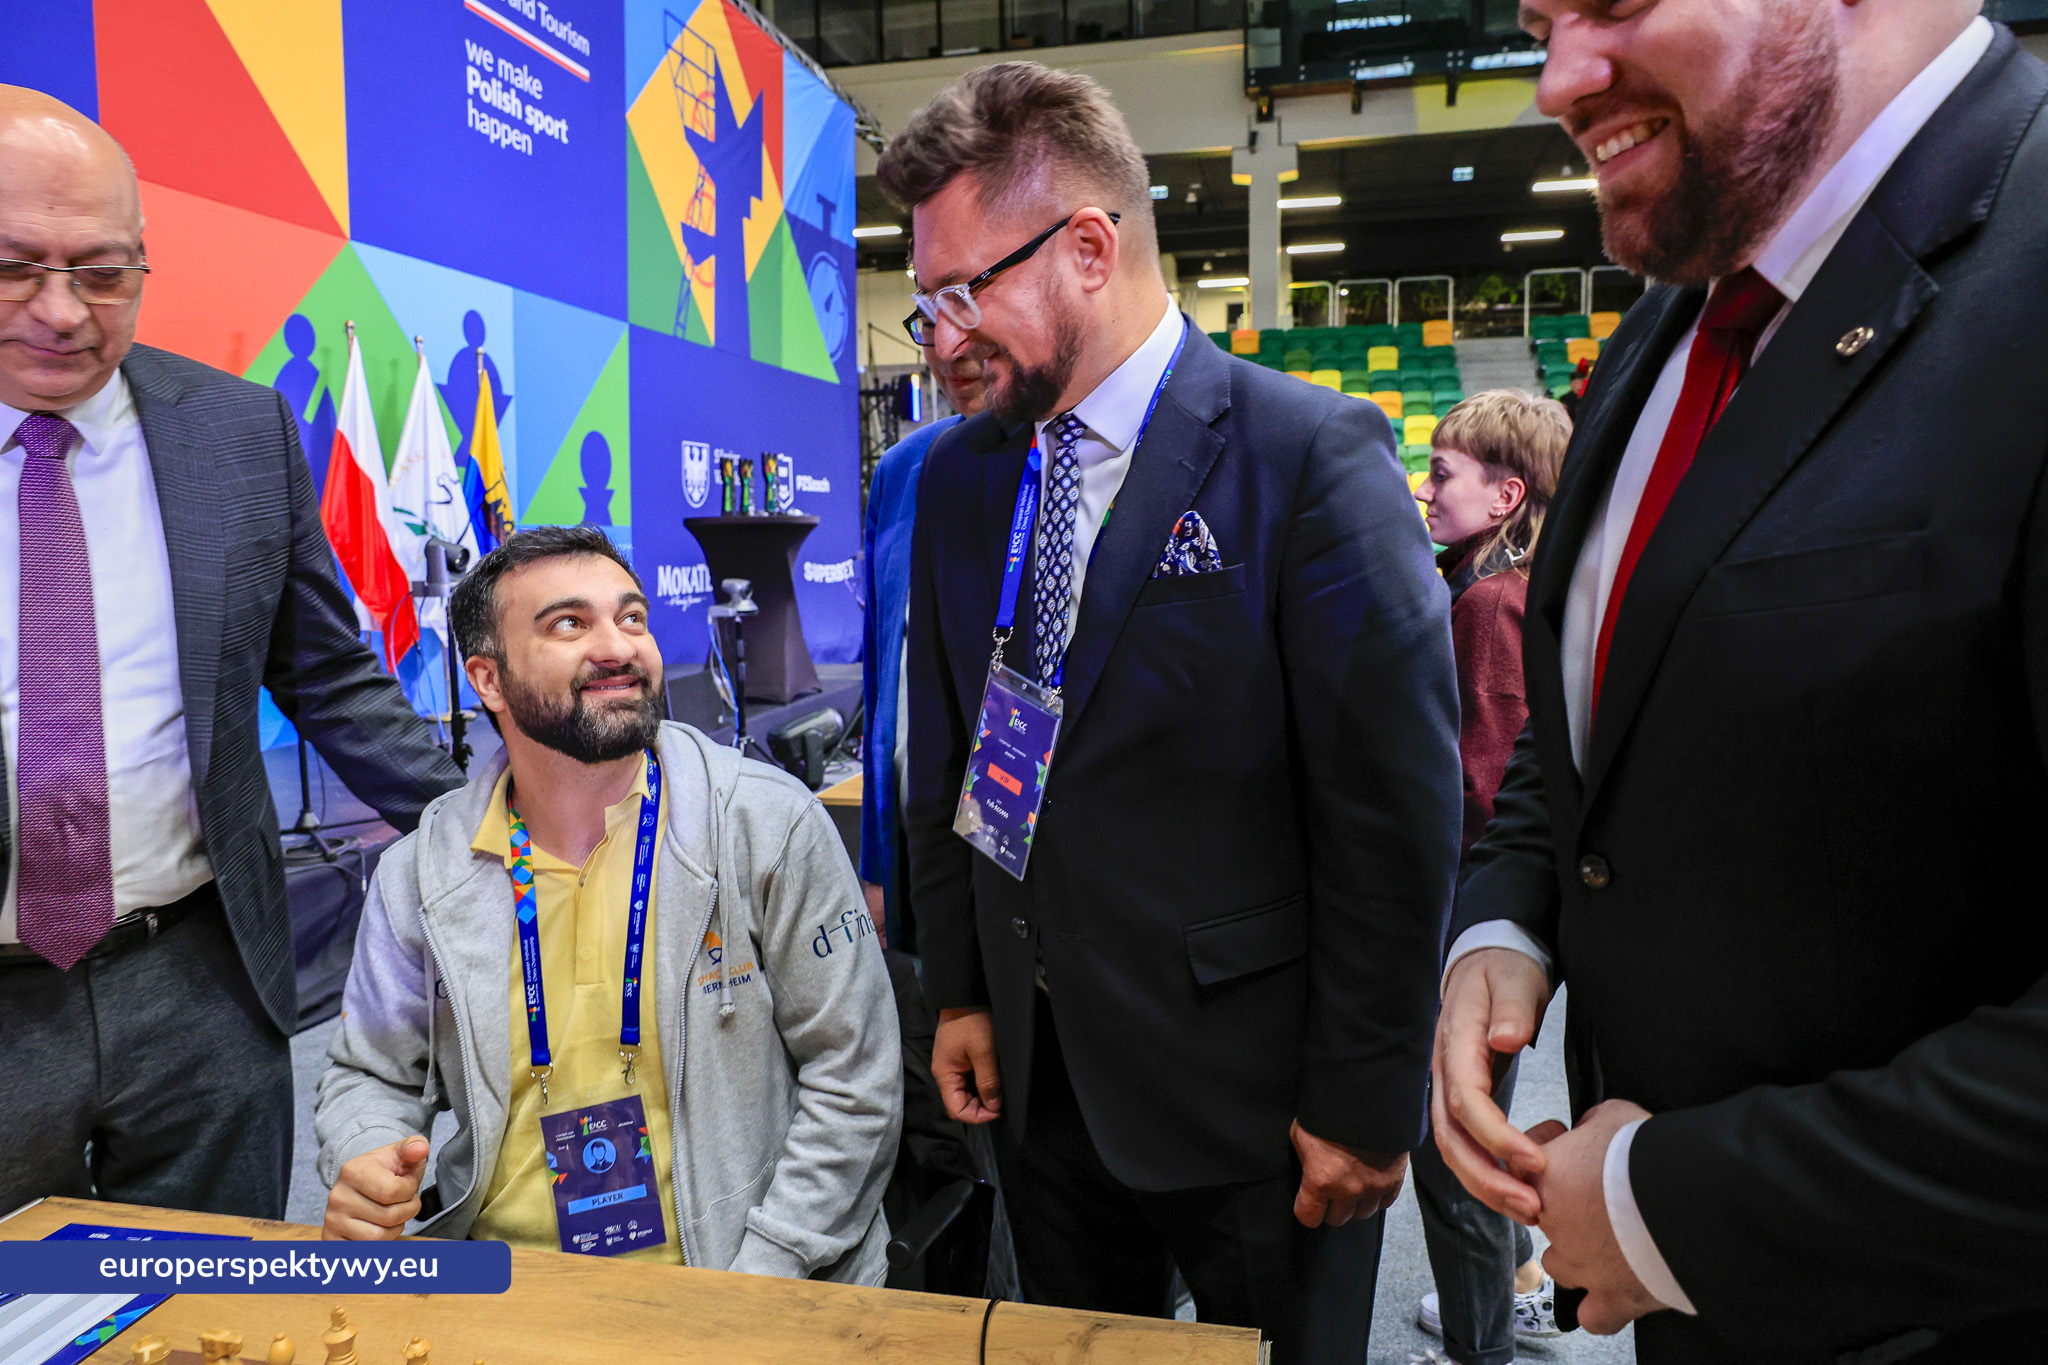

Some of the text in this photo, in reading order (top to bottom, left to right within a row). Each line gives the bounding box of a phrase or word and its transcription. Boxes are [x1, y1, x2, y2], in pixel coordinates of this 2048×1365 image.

[507, 0, 590, 56] and Tourism
[465, 38, 543, 100] we make
[466, 65, 569, 144] Polish sport
[467, 98, 533, 156] happen
[592, 1192, 625, 1207] PLAYER
